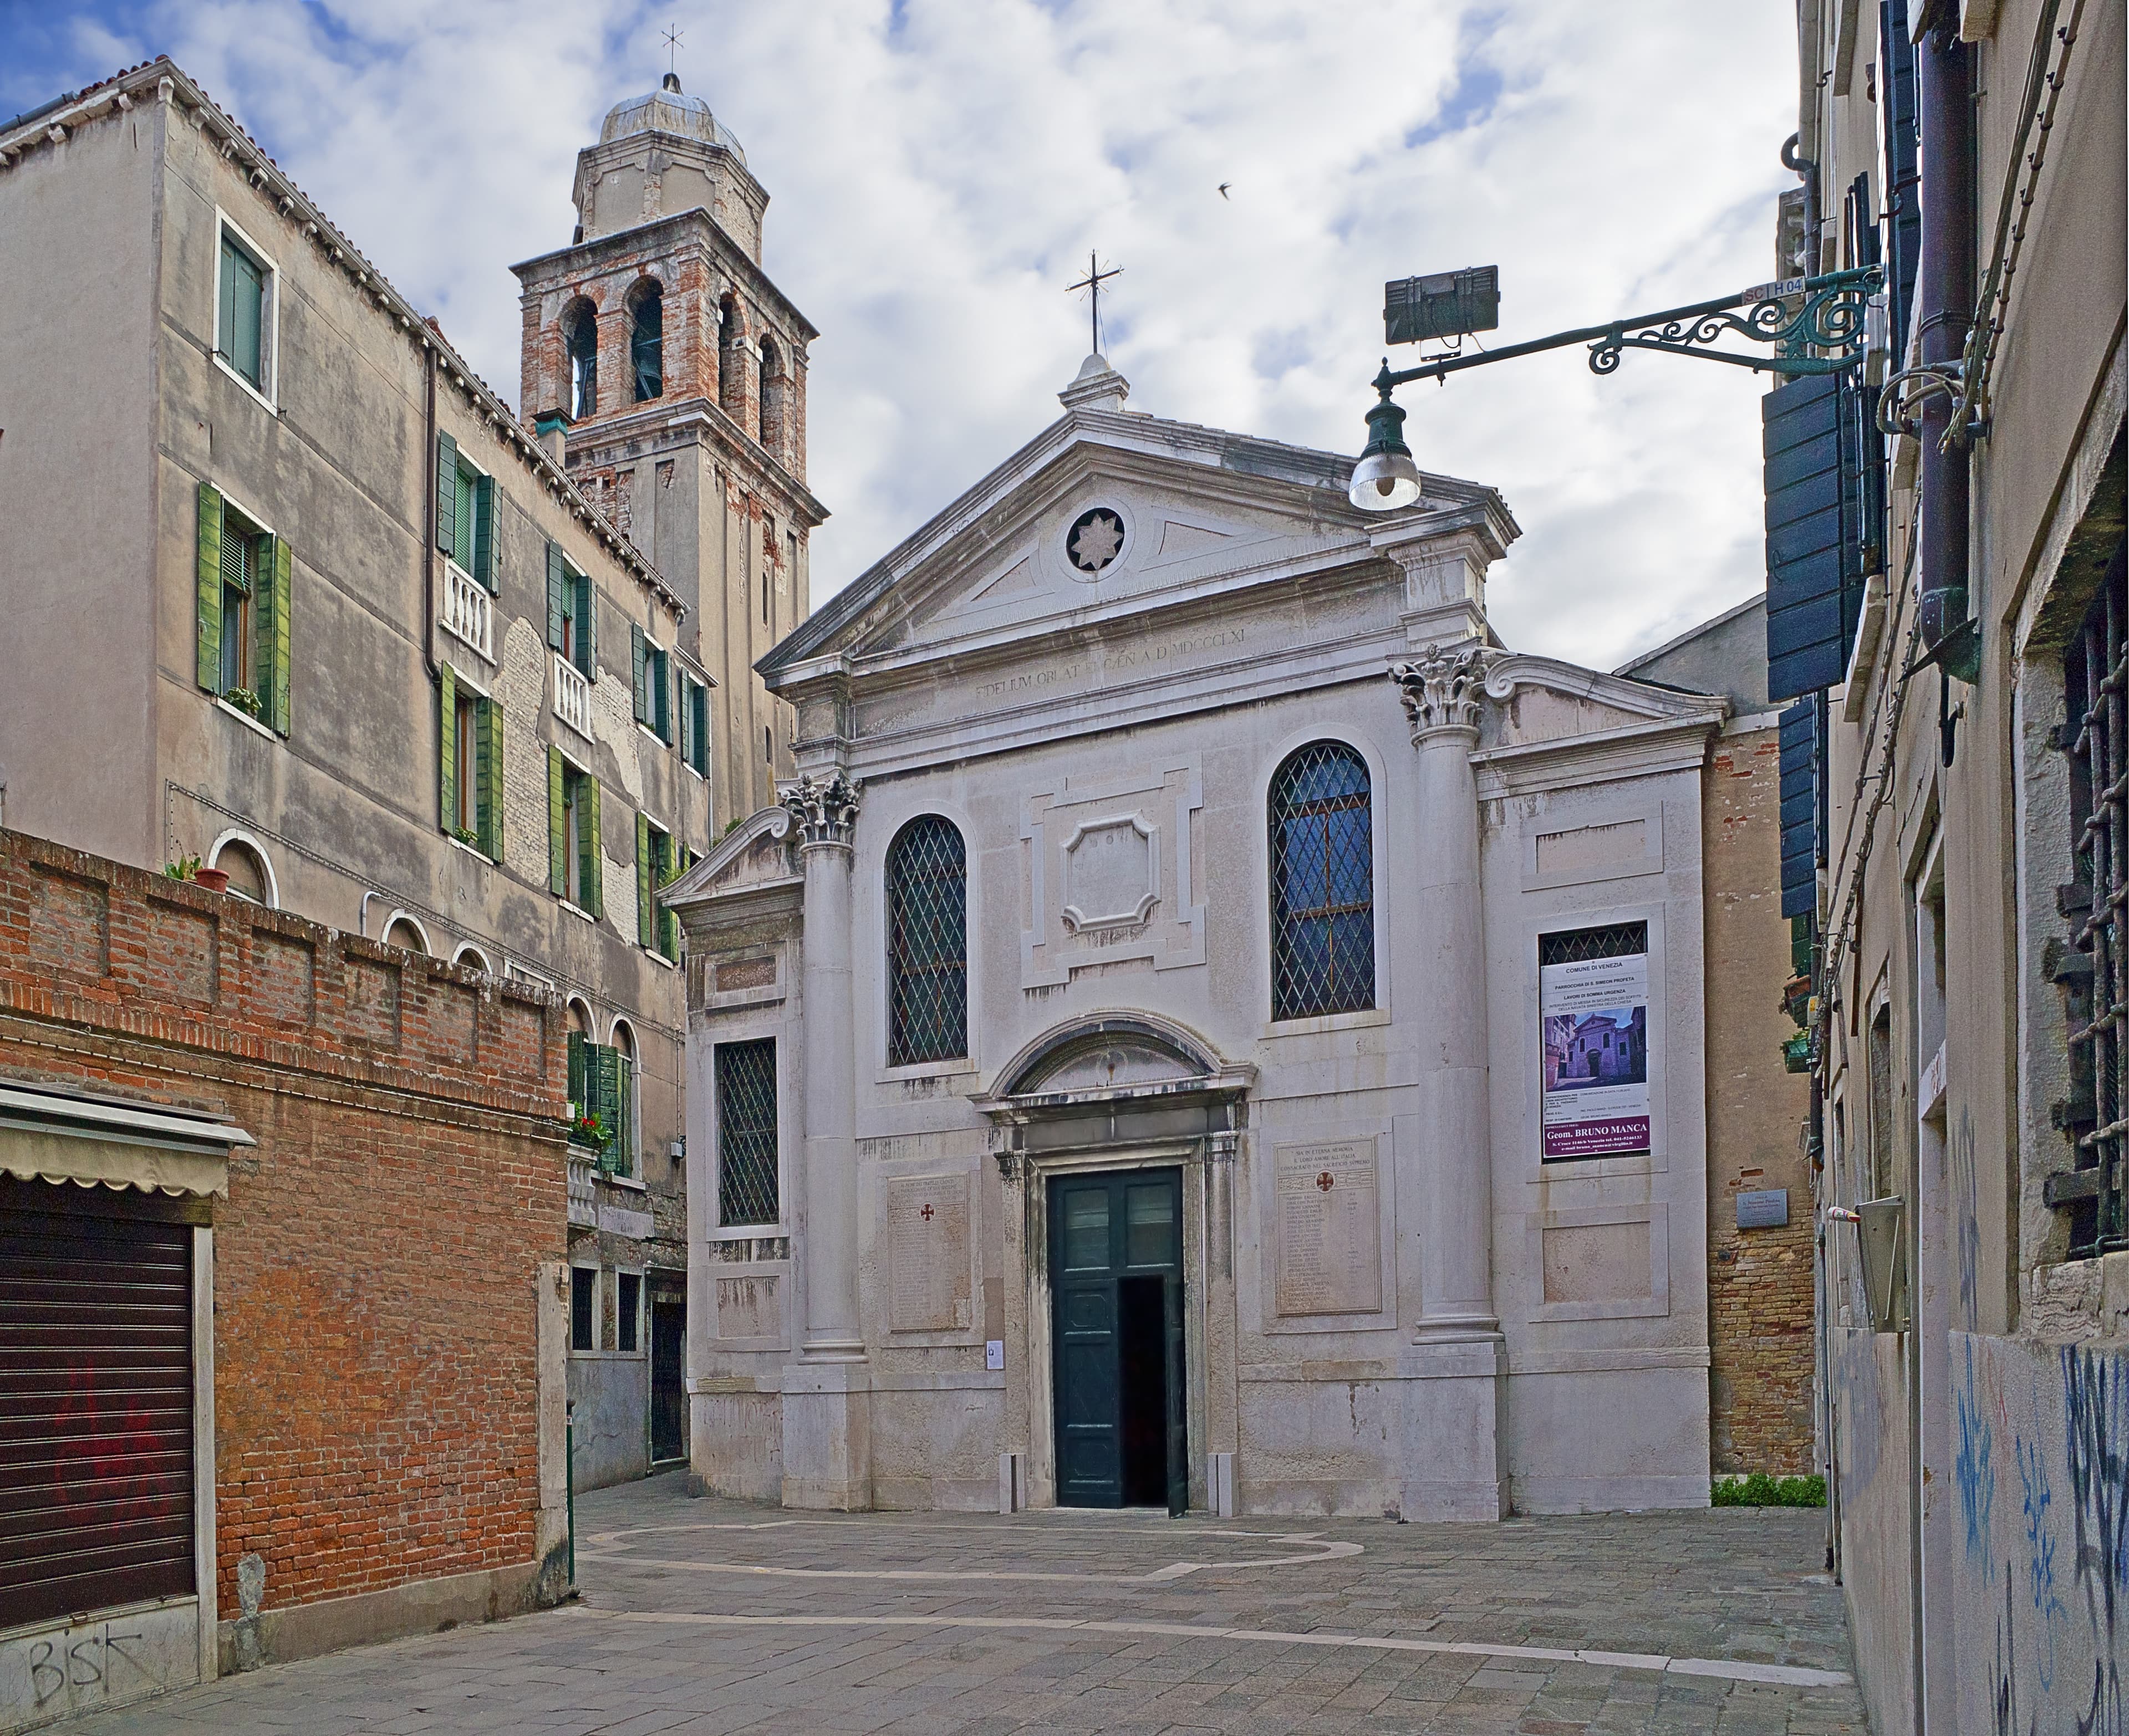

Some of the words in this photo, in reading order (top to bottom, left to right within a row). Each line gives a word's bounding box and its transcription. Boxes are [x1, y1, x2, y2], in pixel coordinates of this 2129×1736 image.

[1745, 288, 1763, 301] SC
[1775, 283, 1784, 295] H
[1787, 279, 1801, 292] 04
[1566, 966, 1591, 974] COMUNE
[1599, 962, 1623, 970] VENEZIA
[1555, 982, 1585, 990] PARROCCHIA
[1547, 1131, 1573, 1140] Geom.
[1575, 1126, 1609, 1137] BRUNO
[1611, 1124, 1647, 1134] MANCA
